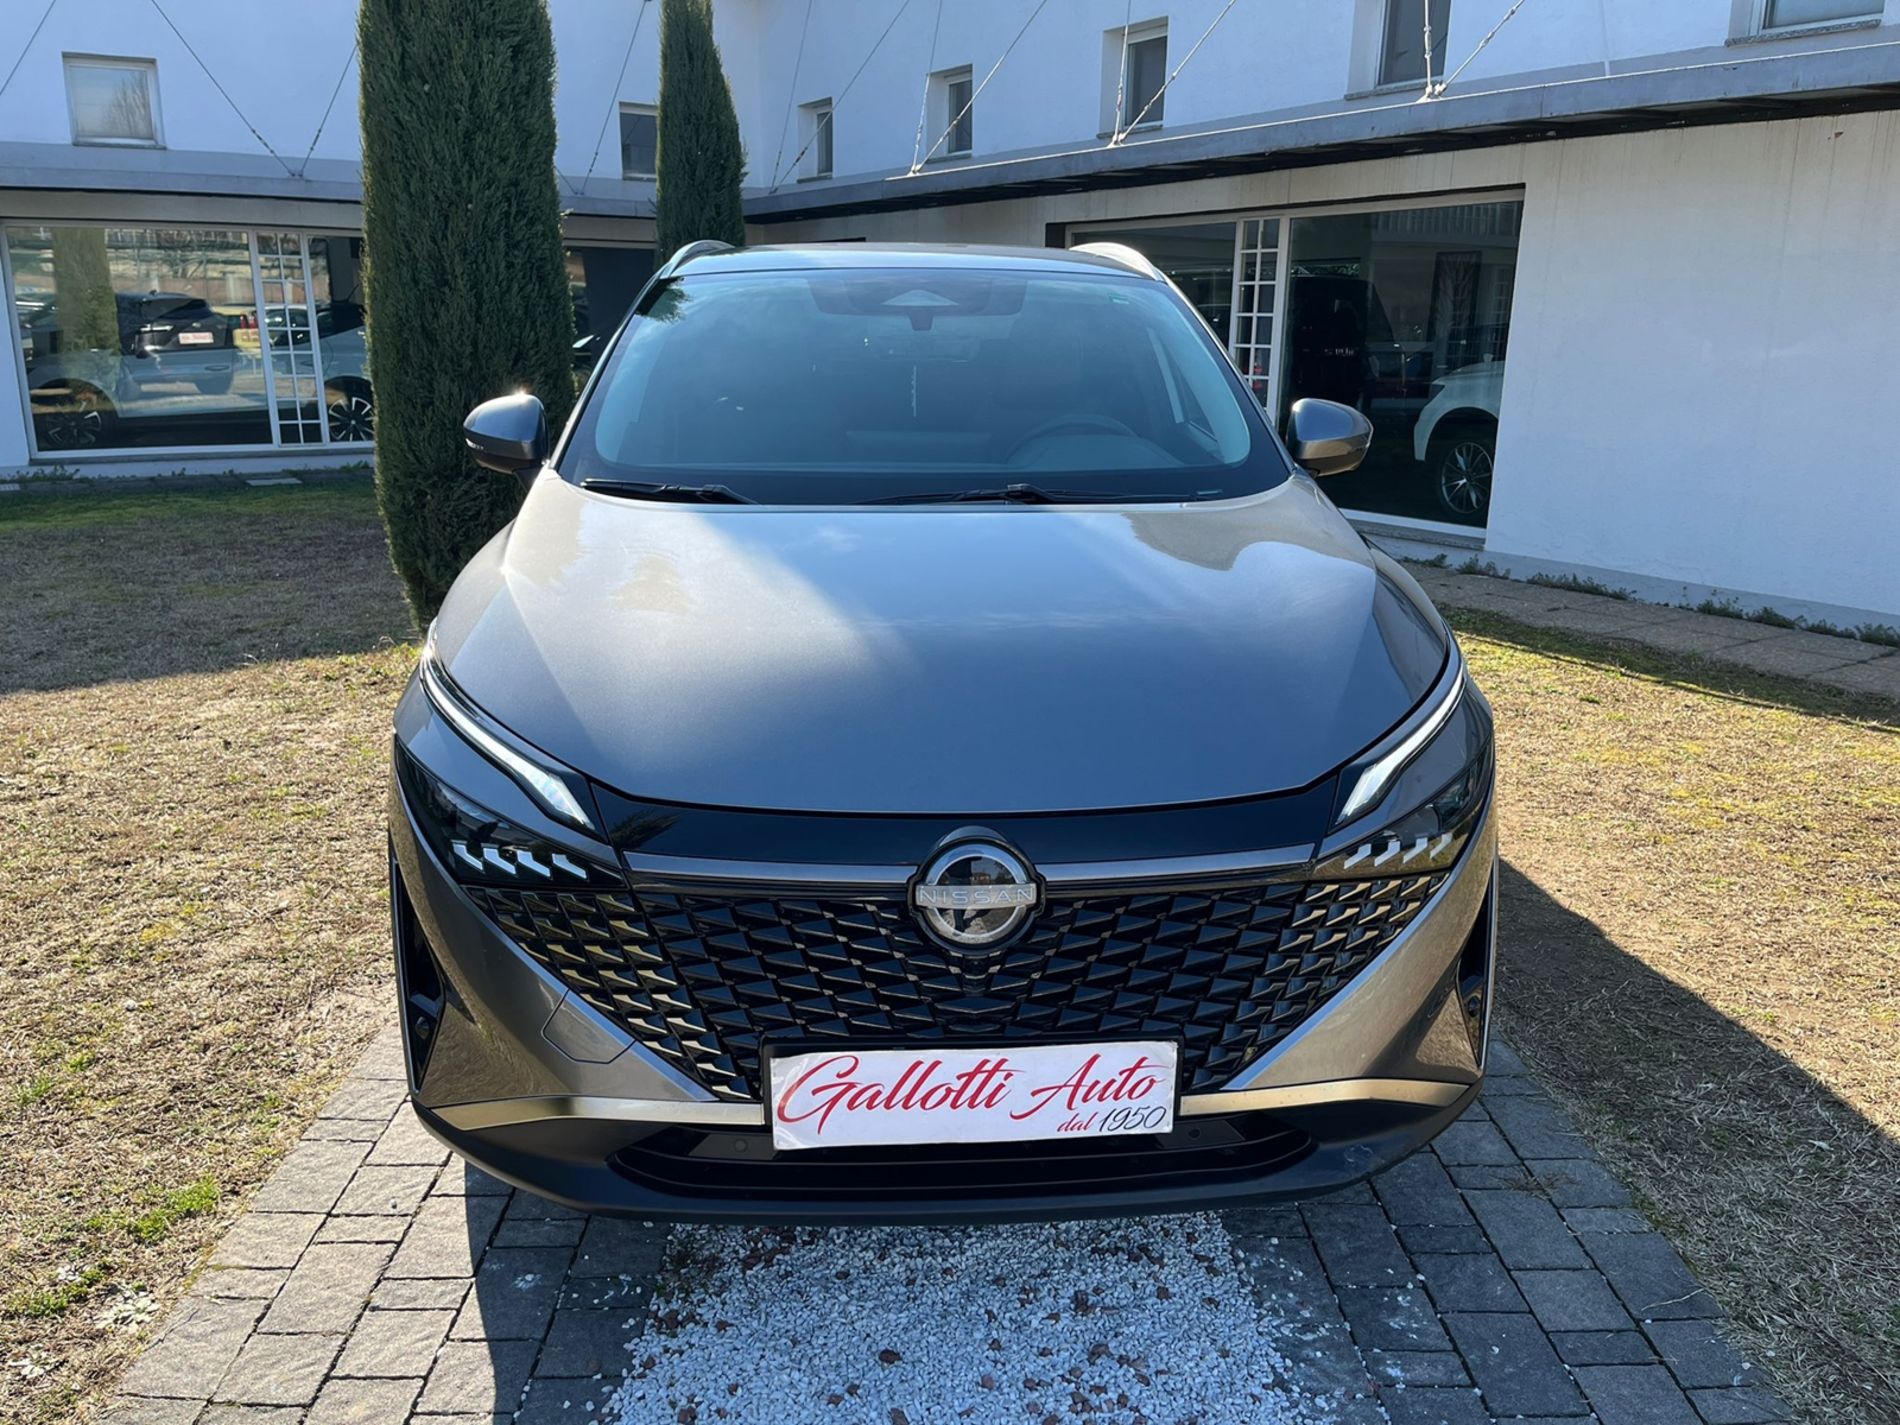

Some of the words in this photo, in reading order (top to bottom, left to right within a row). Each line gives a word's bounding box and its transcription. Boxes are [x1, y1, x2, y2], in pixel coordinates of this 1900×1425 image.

[919, 887, 1034, 905] NISSAN
[776, 1055, 1025, 1135] Gallotti
[1010, 1053, 1169, 1120] Auto
[1057, 1112, 1096, 1133] dal
[1098, 1105, 1168, 1133] 1950
